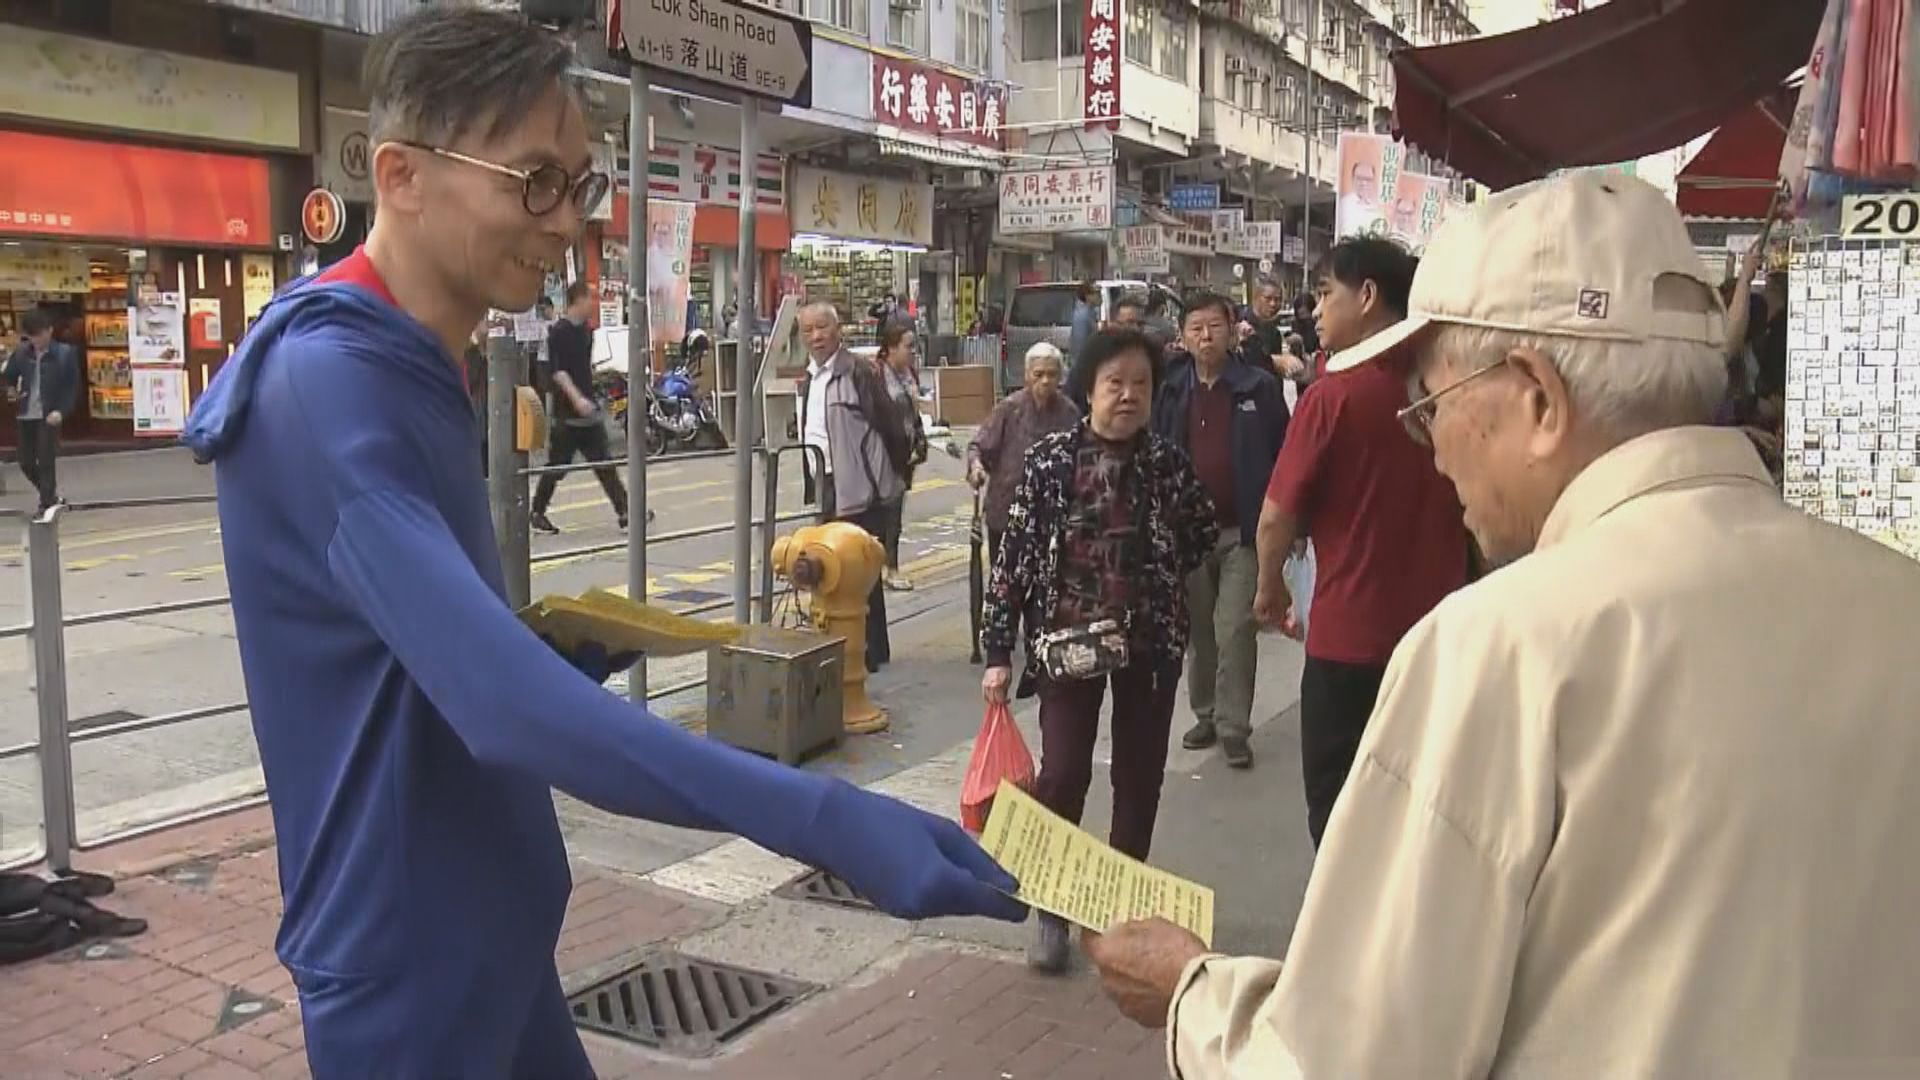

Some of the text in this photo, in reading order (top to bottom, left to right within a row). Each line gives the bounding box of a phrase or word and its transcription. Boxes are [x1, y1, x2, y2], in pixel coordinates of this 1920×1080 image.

[688, 0, 729, 32] Shan
[734, 13, 776, 46] Road
[680, 37, 748, 82] 落山道
[1851, 199, 1920, 235] 20
